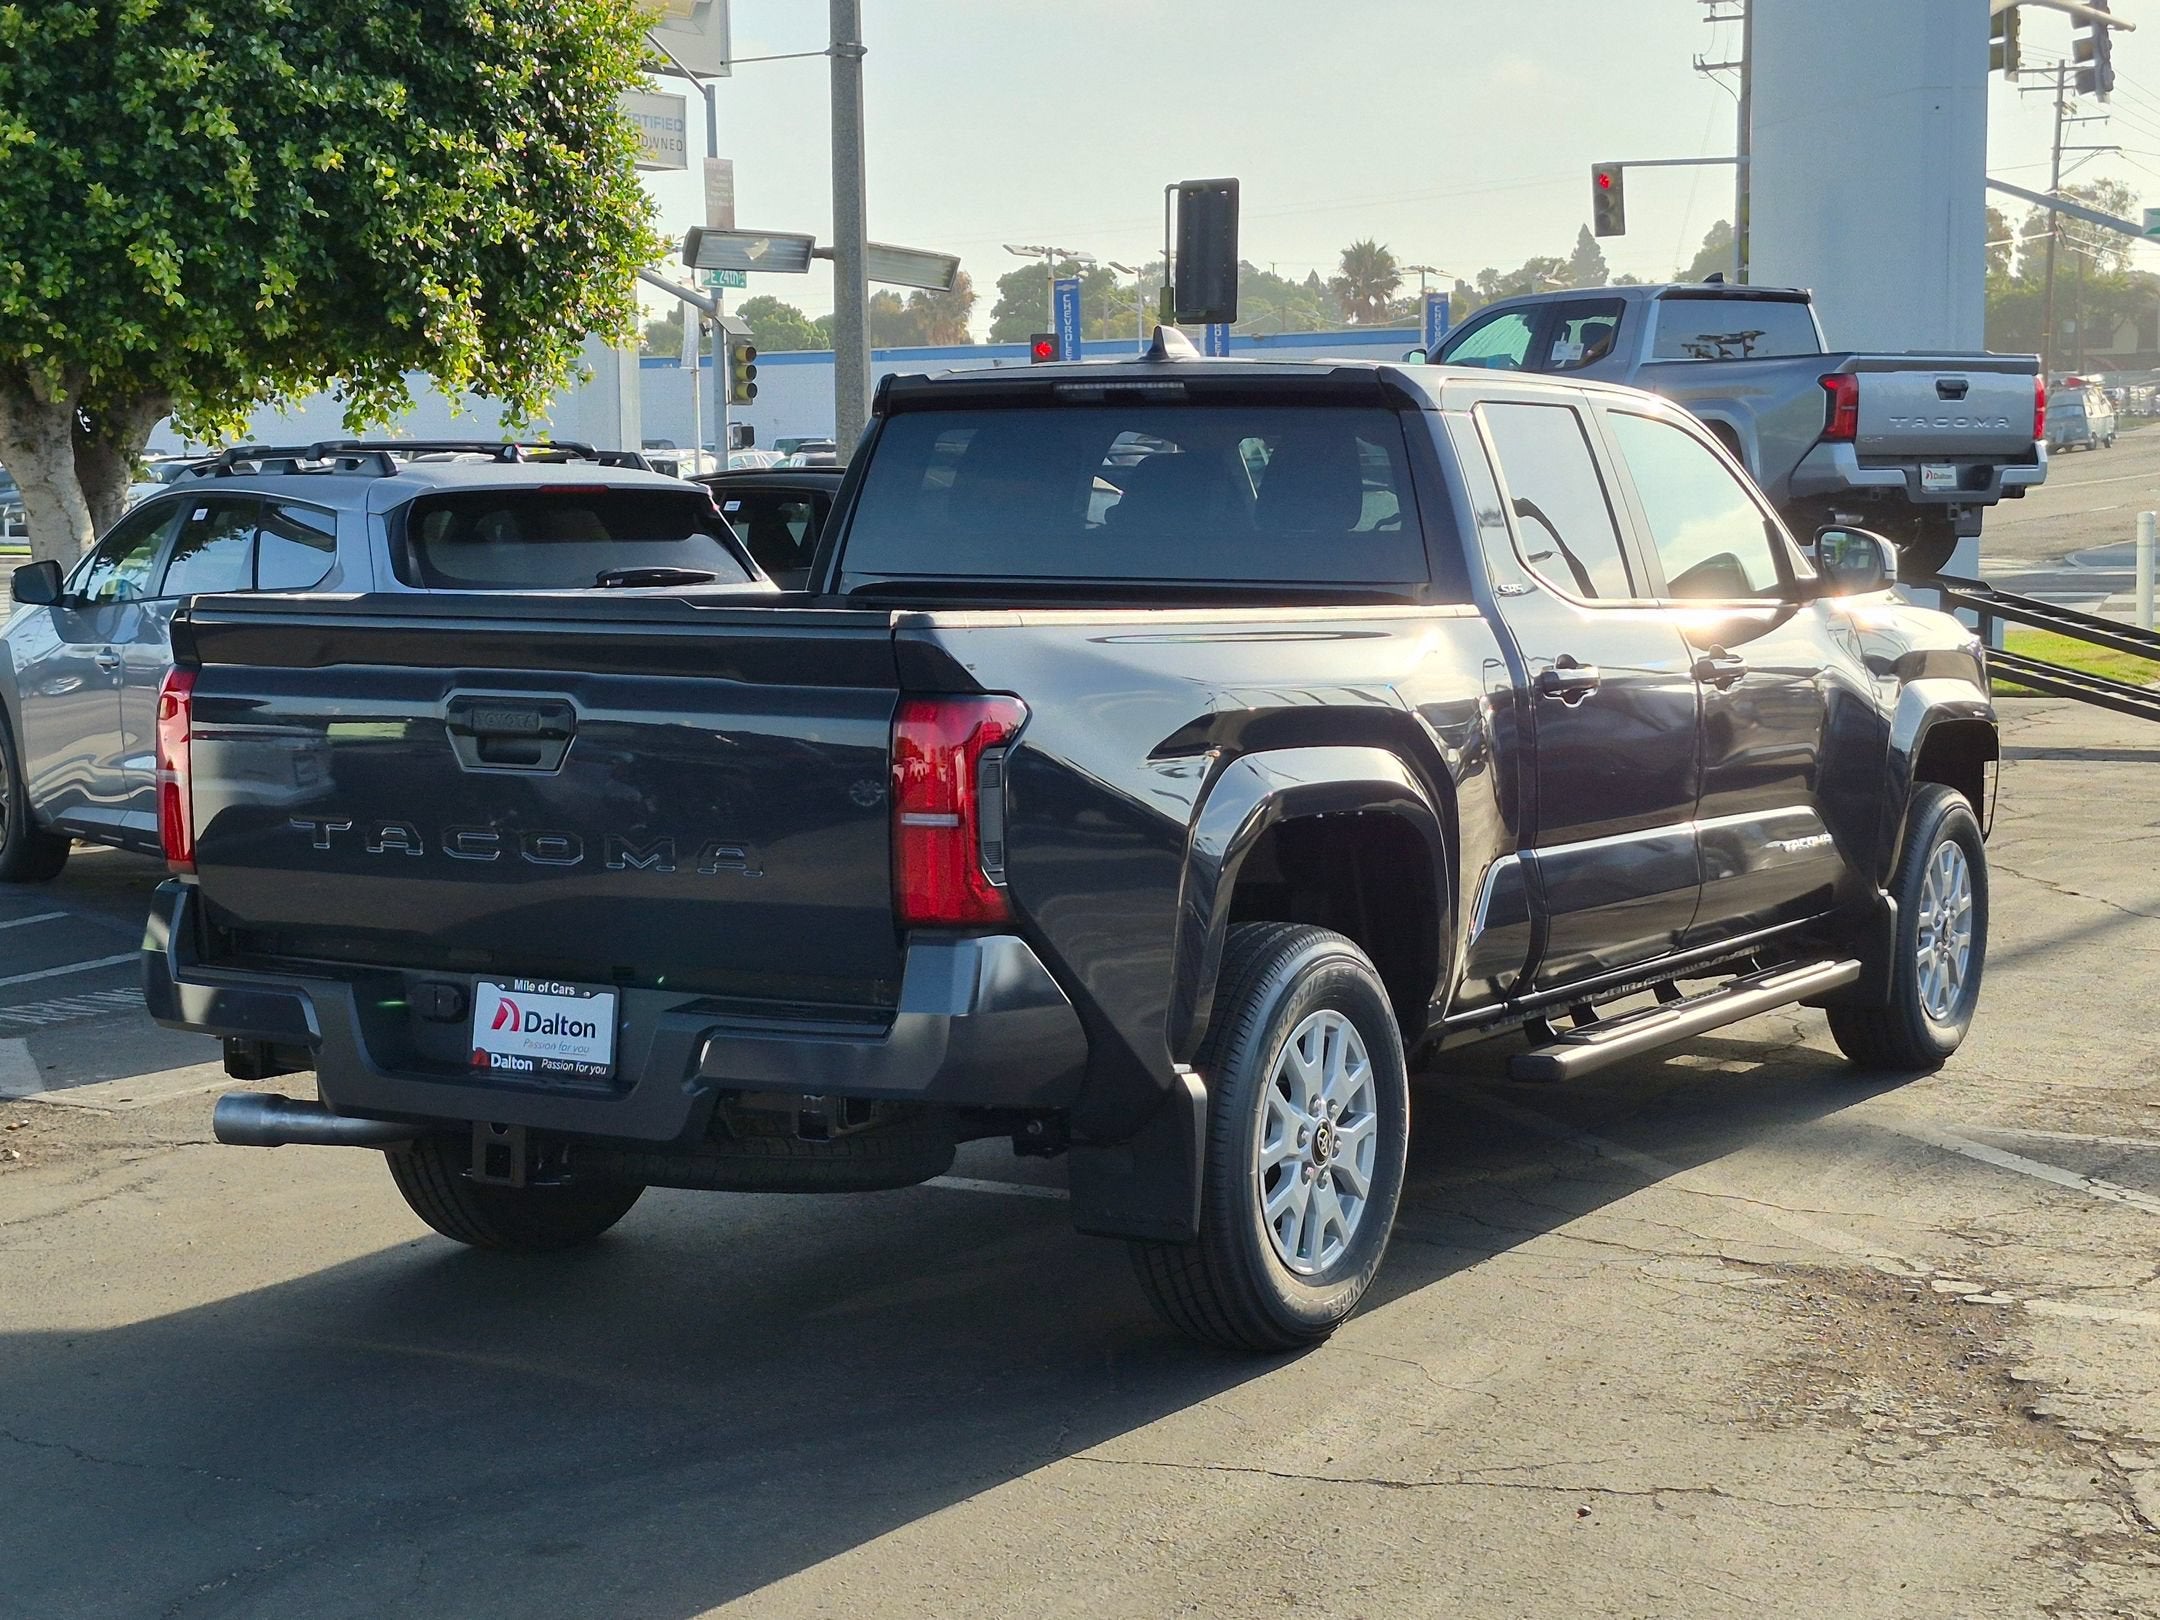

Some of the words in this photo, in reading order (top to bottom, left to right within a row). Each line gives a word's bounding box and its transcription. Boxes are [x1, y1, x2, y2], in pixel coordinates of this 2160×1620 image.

[1889, 416, 2010, 429] TACOMA
[473, 710, 538, 729] TOYOTA
[289, 815, 763, 877] TACOMA
[514, 979, 535, 992] Mile
[538, 982, 549, 992] of
[551, 982, 575, 995] Cars
[524, 1011, 596, 1038] Dalton
[523, 1039, 556, 1050] Passion
[558, 1041, 571, 1051] for
[573, 1044, 590, 1054] you
[490, 1053, 533, 1071] Dalton
[541, 1058, 573, 1071] Passion
[575, 1062, 588, 1072] for
[589, 1065, 607, 1075] you
